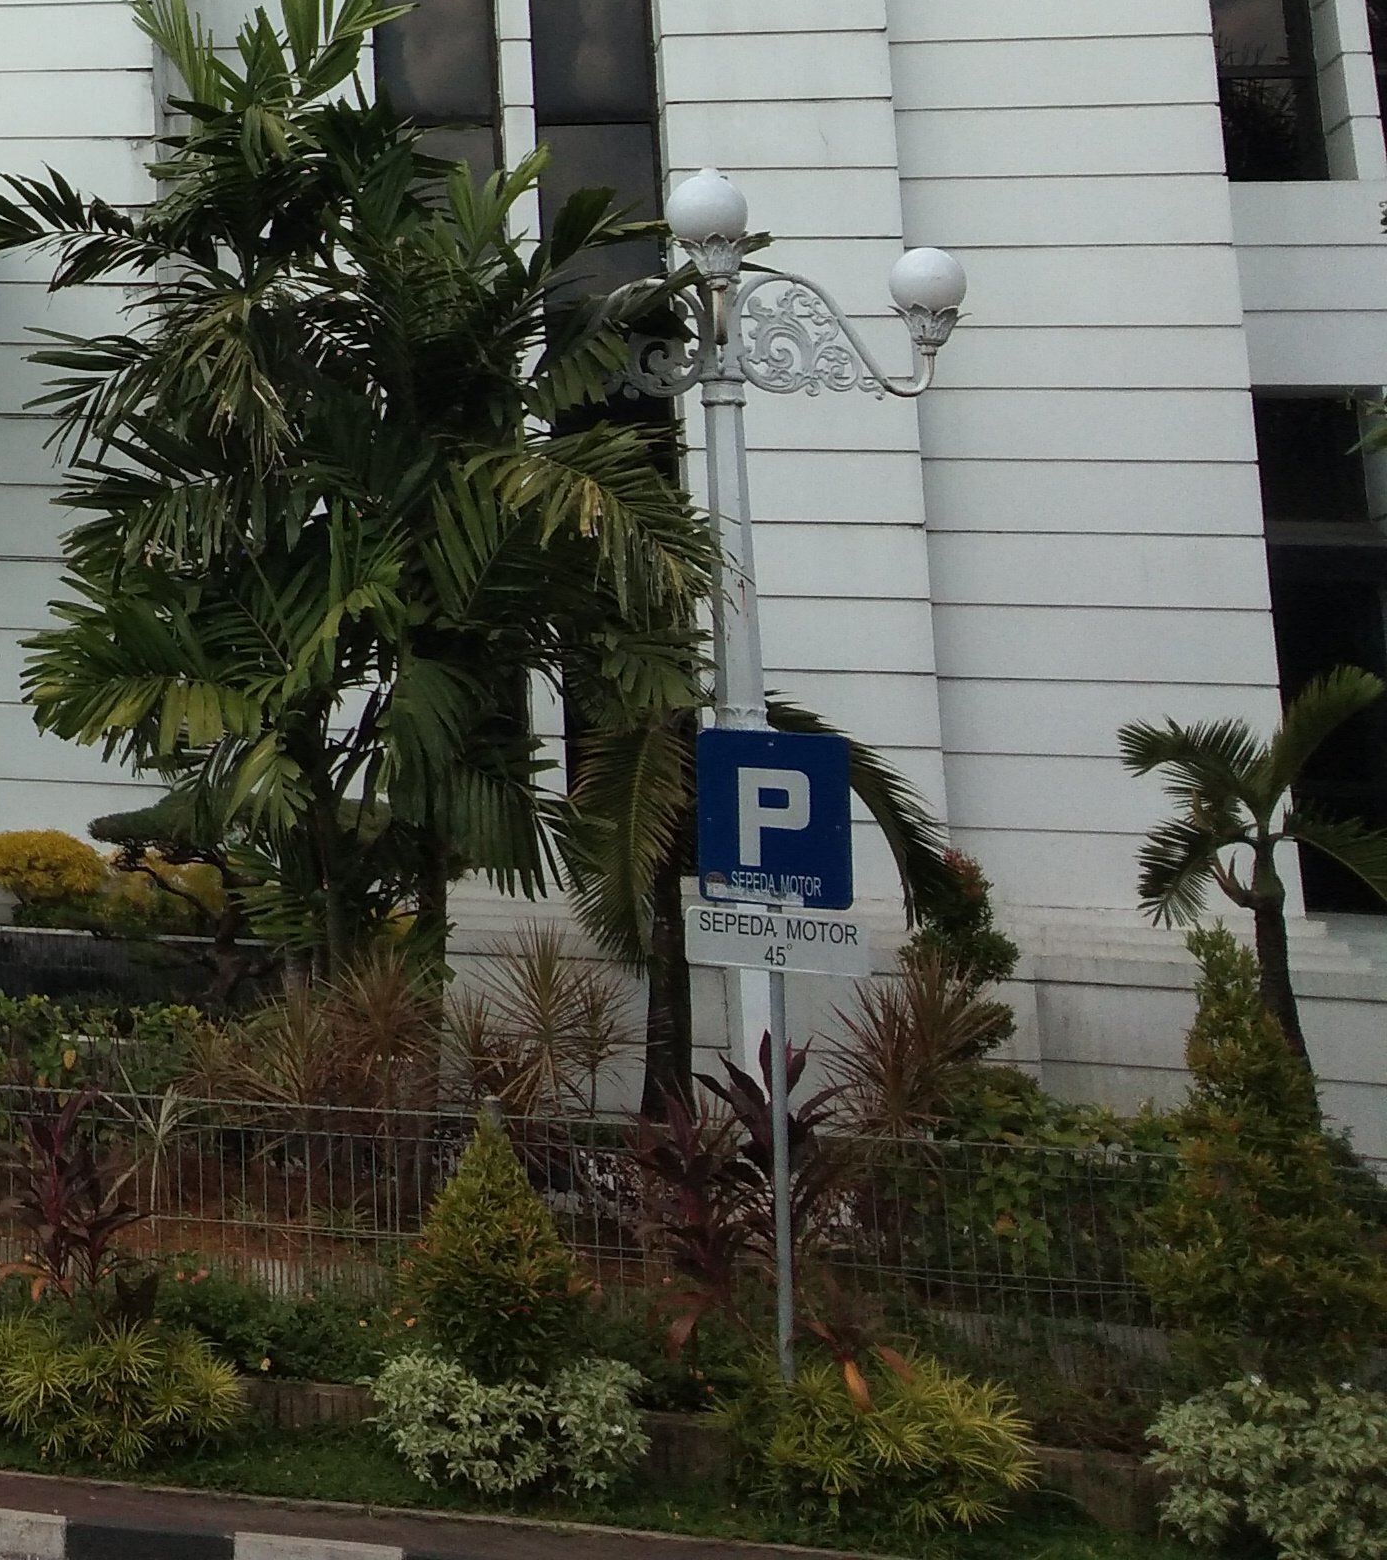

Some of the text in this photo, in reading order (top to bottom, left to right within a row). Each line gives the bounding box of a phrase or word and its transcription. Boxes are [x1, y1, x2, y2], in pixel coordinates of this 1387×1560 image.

[738, 766, 810, 866] P
[731, 870, 822, 897] SEPEDA MOTOR
[699, 910, 858, 945] SEPEDA MOTOR
